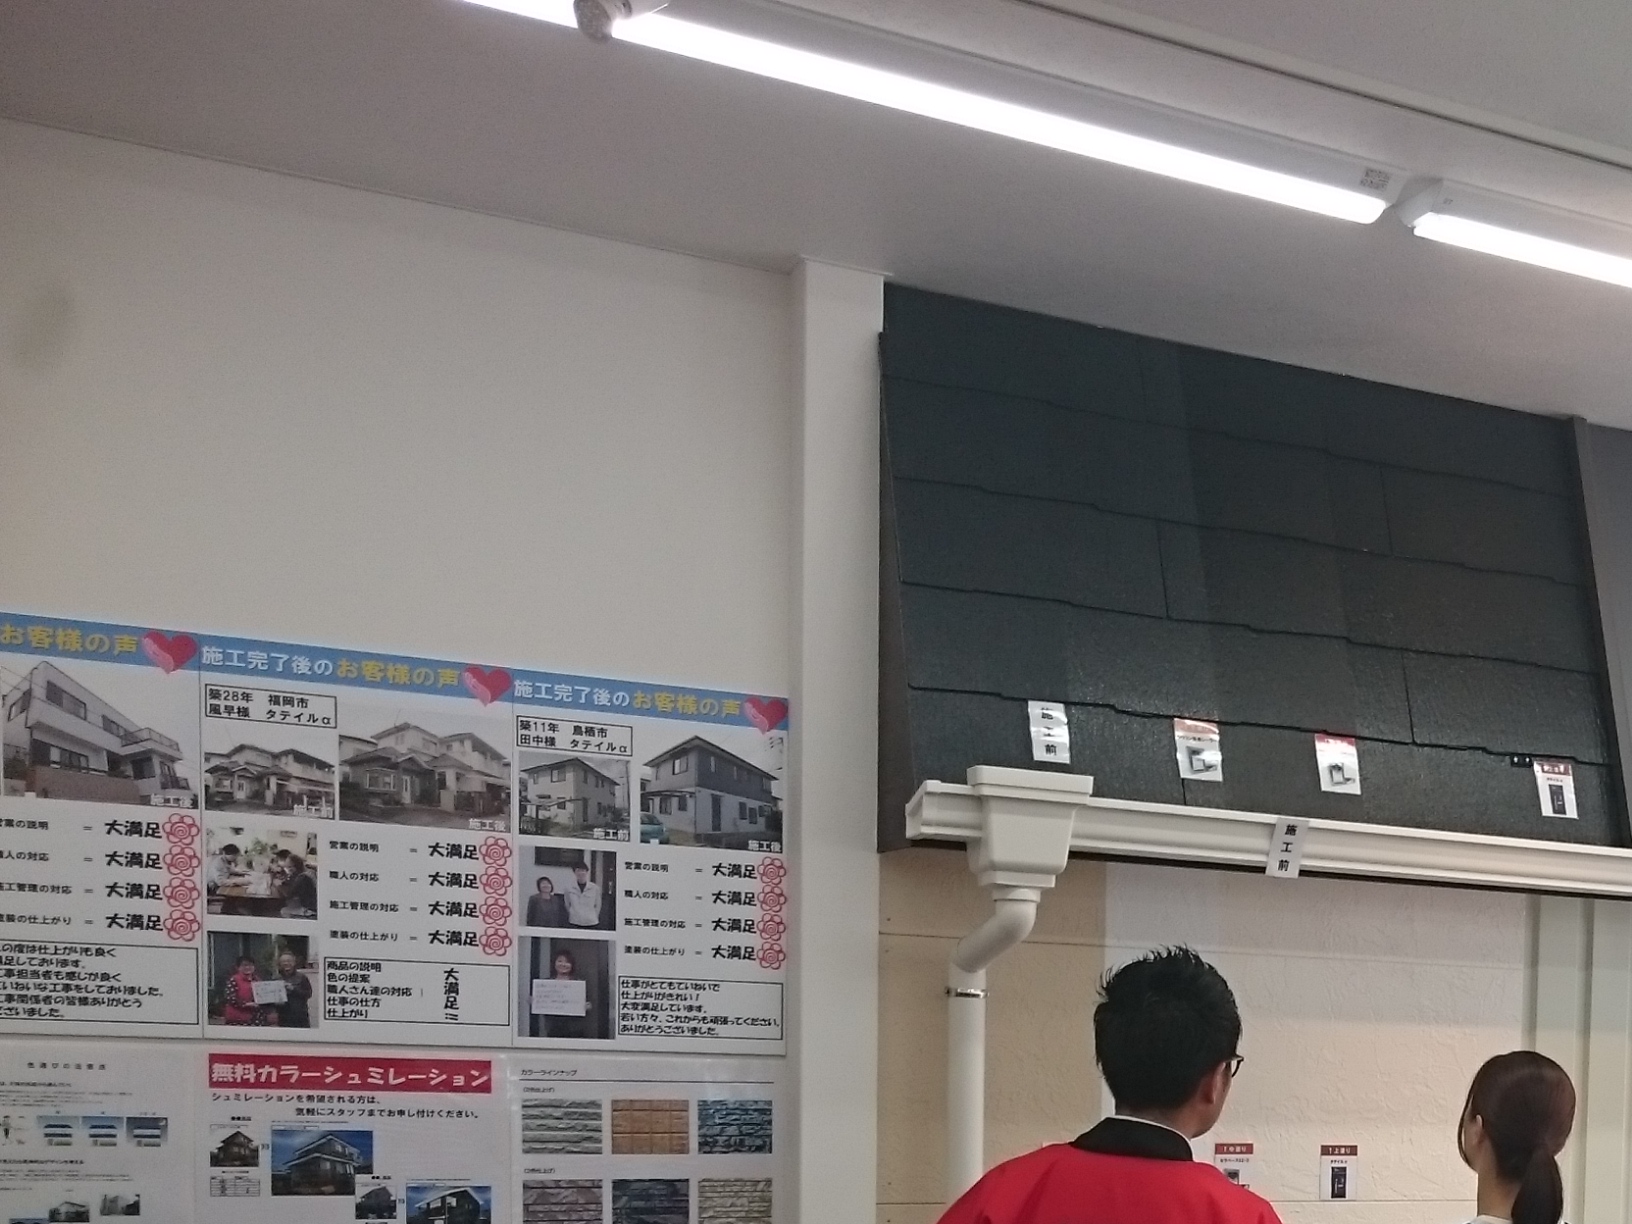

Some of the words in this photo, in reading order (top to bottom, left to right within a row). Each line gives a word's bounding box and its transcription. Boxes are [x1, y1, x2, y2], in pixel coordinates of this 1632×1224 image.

[201, 645, 461, 687] 施工完了後のお客様の声
[208, 689, 253, 703] 築28年
[268, 693, 309, 708] 福岡市
[513, 679, 741, 717] 施工完了後のお客様の声
[208, 704, 251, 718] 風早様
[519, 719, 560, 734] 築11年
[572, 725, 608, 739] 鳥栖市
[519, 734, 556, 748] 田中様
[104, 819, 162, 838] 大満足
[329, 841, 379, 853] 営業の説明
[428, 842, 479, 860] 大満足
[1277, 823, 1297, 871] 施工前
[105, 851, 163, 869] 大満足
[624, 861, 669, 873] 営業の説明
[712, 862, 757, 879] 大満足
[329, 871, 379, 882] 職人の対応
[428, 872, 479, 889] 大満足
[105, 882, 163, 900] 大満足
[624, 890, 668, 901] 職人の対応
[711, 890, 757, 907] 大満足
[329, 900, 399, 913] 施工管理の対応
[428, 901, 480, 918] 大満足
[105, 913, 163, 931] 大満足
[624, 917, 686, 929] 施工管理の対応
[711, 917, 757, 934] 大満足
[329, 930, 398, 942] 塗装の仕上がり
[428, 930, 479, 947] 大満足
[0, 943, 117, 958] の度は仕上がりも良く
[624, 945, 686, 956] 塗装の仕上がり
[711, 944, 757, 961] 大満足
[0, 956, 86, 969] 足しております。
[327, 961, 382, 973] 商品の説明
[327, 997, 381, 1008] 仕事の仕方
[327, 1008, 368, 1019] 仕上がり
[211, 1062, 489, 1088] 無料カラーシュミレーション
[211, 1092, 382, 1105] シュミレーションを希望される方は、
